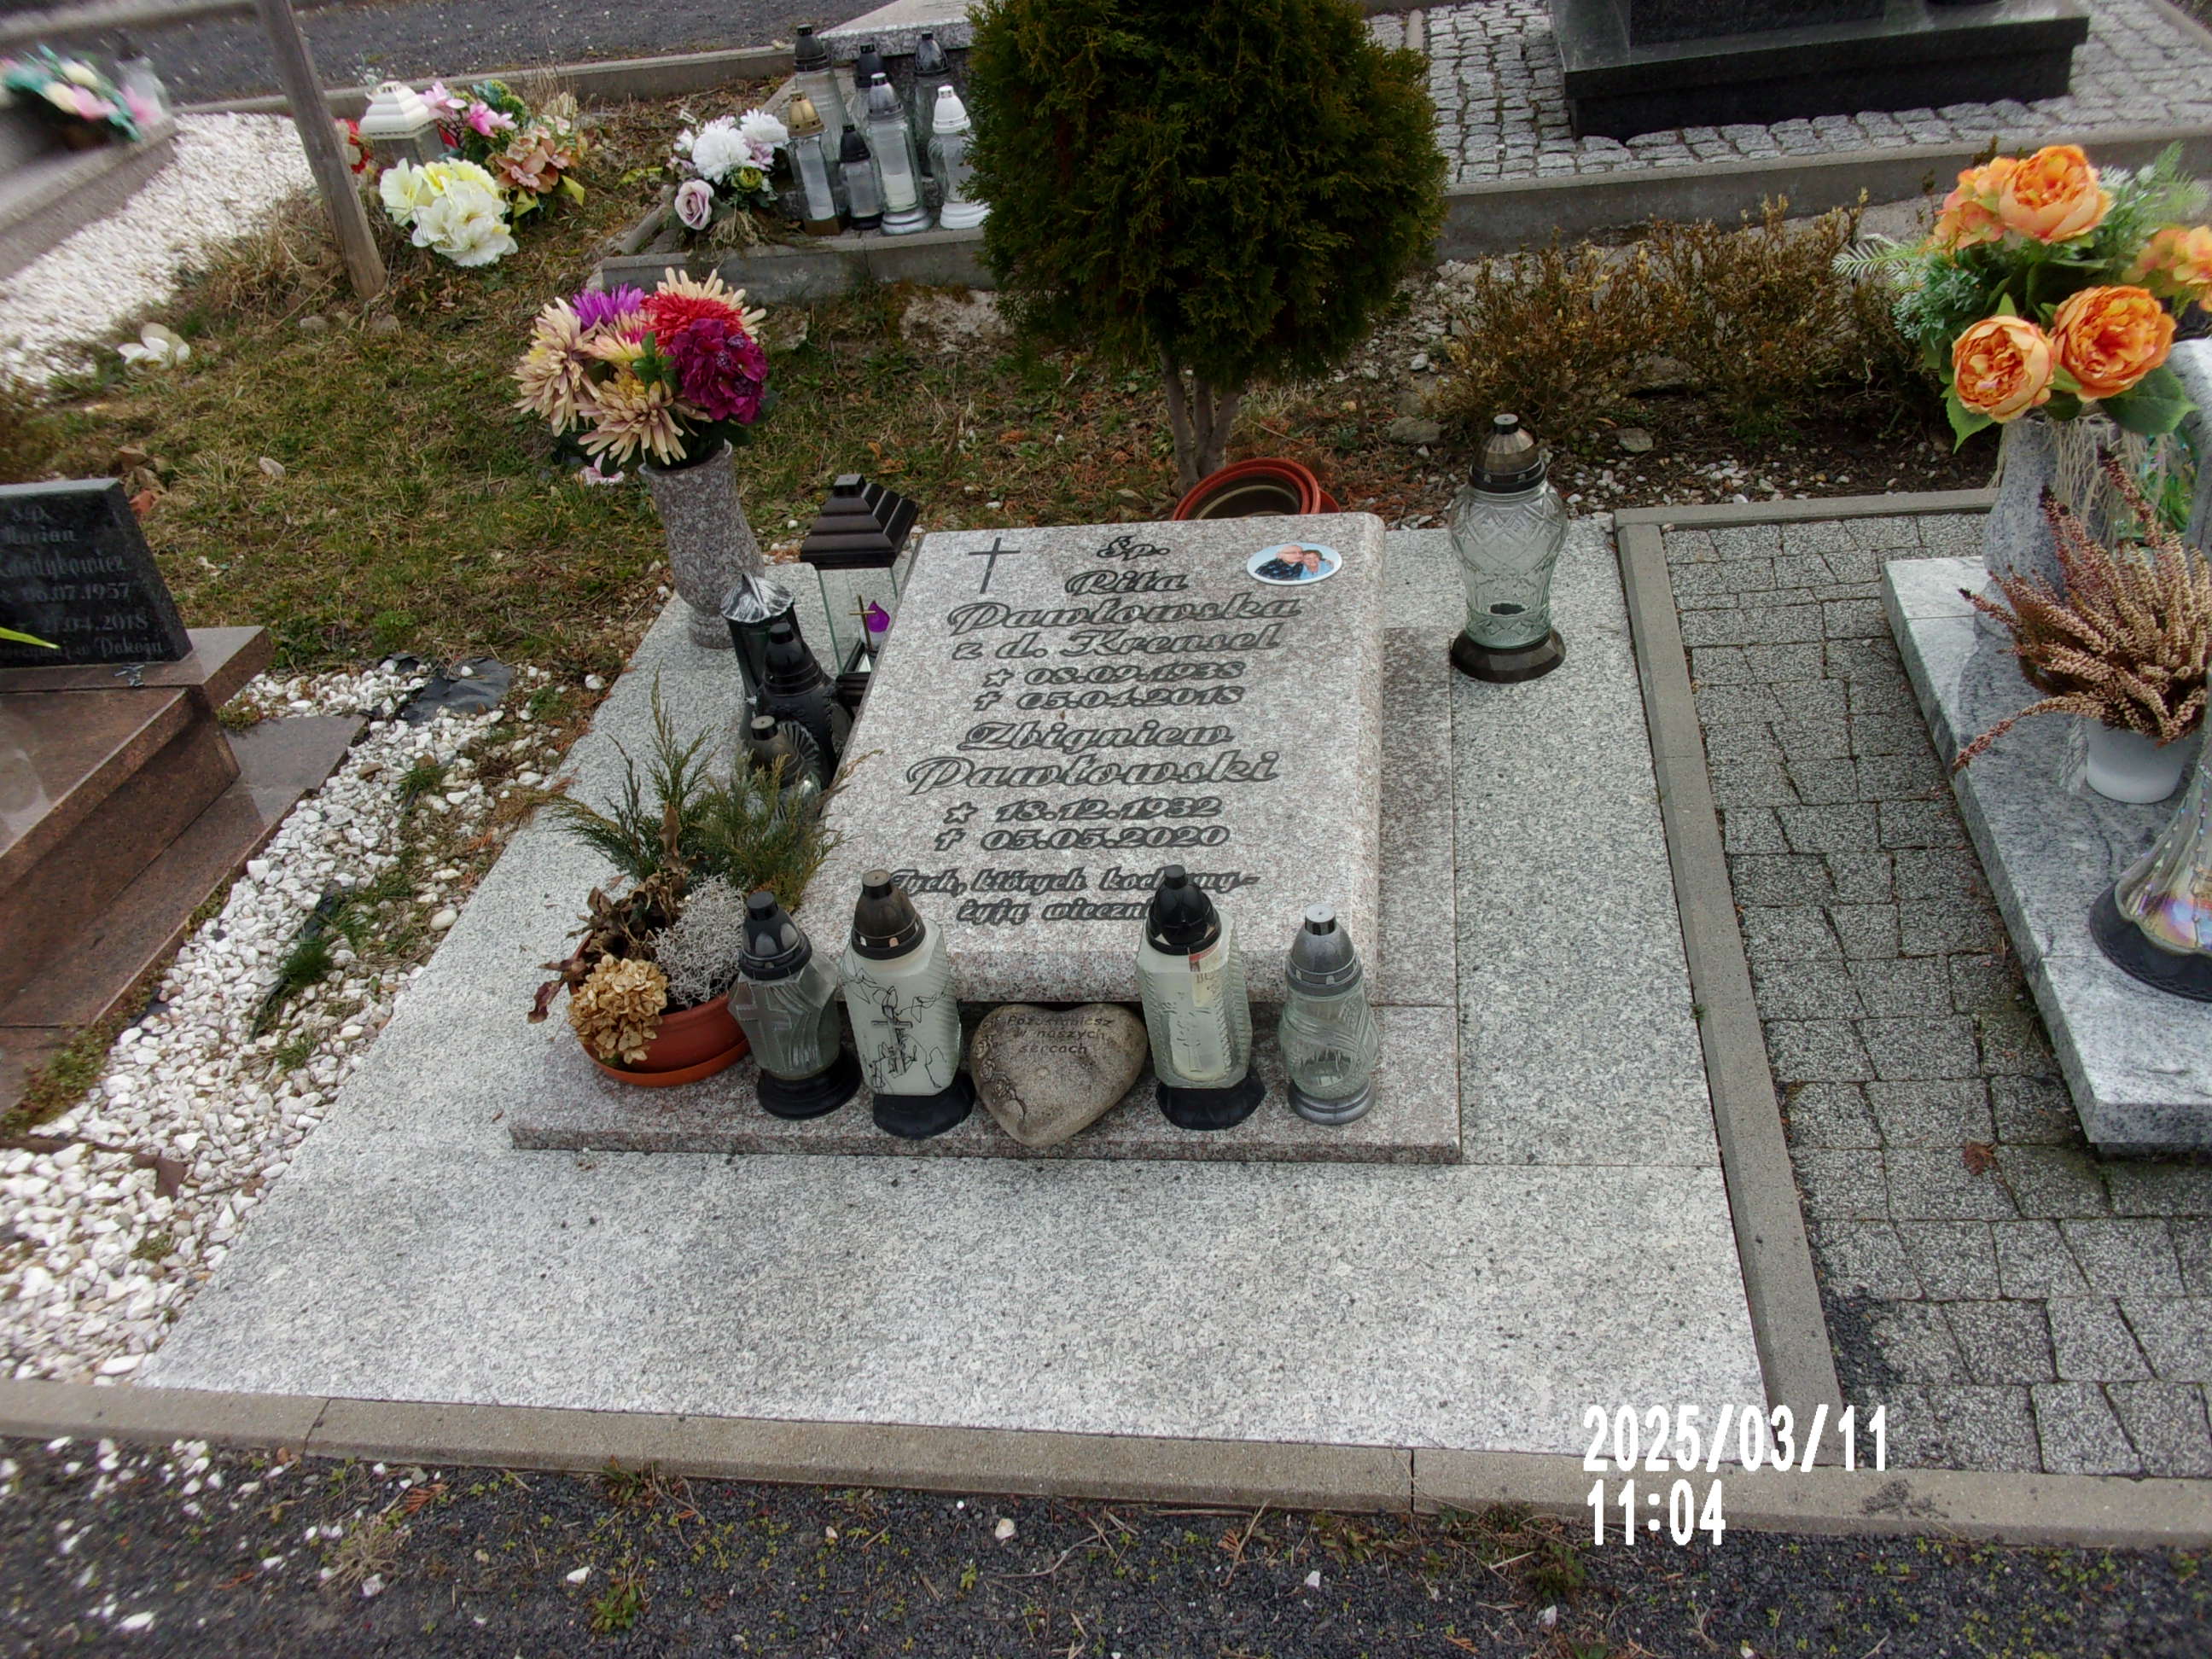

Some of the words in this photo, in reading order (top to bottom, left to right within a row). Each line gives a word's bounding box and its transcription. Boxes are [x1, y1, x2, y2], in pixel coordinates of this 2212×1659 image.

[1065, 569, 1190, 596] Rita
[946, 591, 1304, 637] Pawłowska
[952, 641, 984, 661] z
[995, 632, 1048, 659] d.
[1059, 622, 1284, 657] Krensel
[1024, 661, 1247, 685] 08.09.1938
[1016, 684, 1247, 710] 05.04.2018
[956, 719, 1236, 755] Zbigniew
[905, 749, 1282, 795] Pawłowski
[995, 796, 1224, 824] 18.12.1932
[981, 825, 1231, 852] 05.05.2020
[891, 869, 967, 898] Tych,
[971, 866, 1088, 895] których
[1099, 864, 1260, 894] kocmy-
[956, 898, 1032, 927] żyją
[1041, 895, 1154, 922] wieczn
[1037, 1028, 1106, 1040] naszych
[1018, 1042, 1088, 1055] sercach
